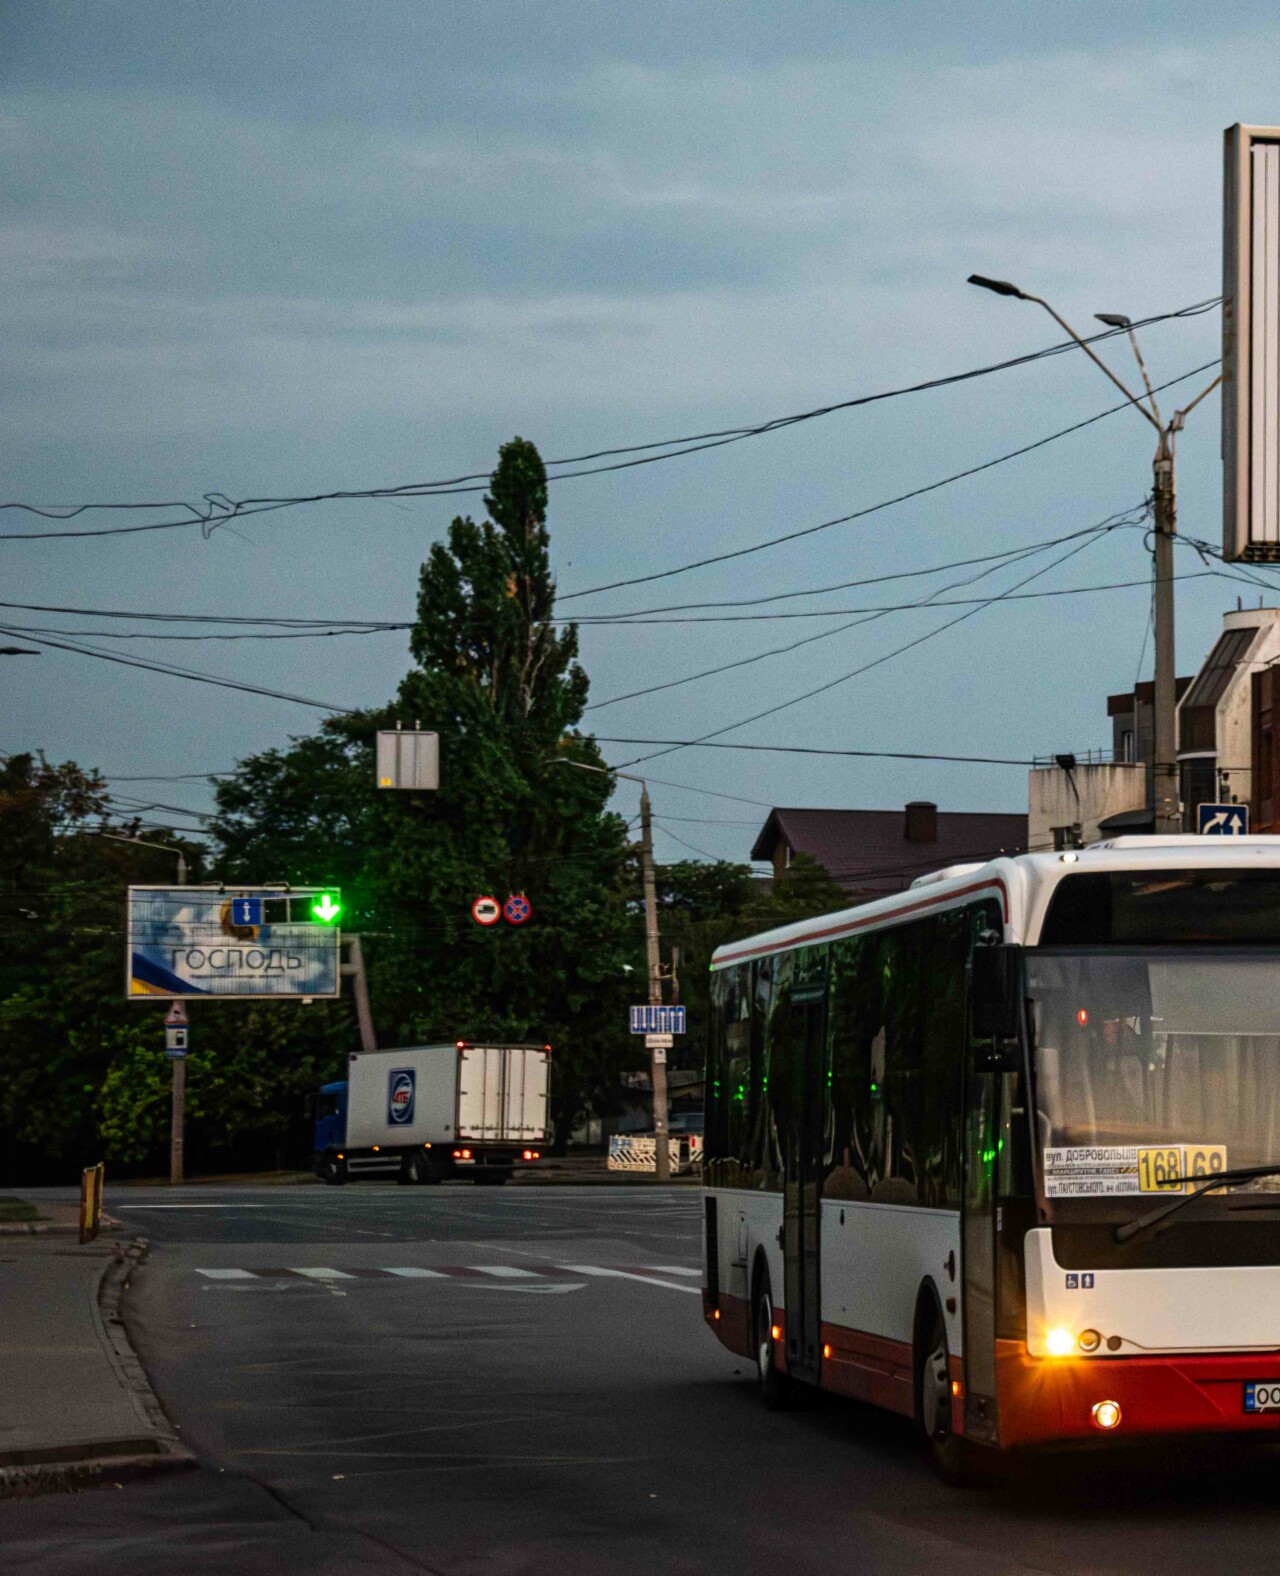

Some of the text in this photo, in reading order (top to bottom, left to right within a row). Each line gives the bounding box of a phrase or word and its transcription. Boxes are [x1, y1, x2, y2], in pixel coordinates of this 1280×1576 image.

[171, 948, 302, 972] ГОСПОДЬ
[1065, 1148, 1137, 1162] ДОБРОВОЛЬЦІВ
[1141, 1149, 1179, 1189] 168
